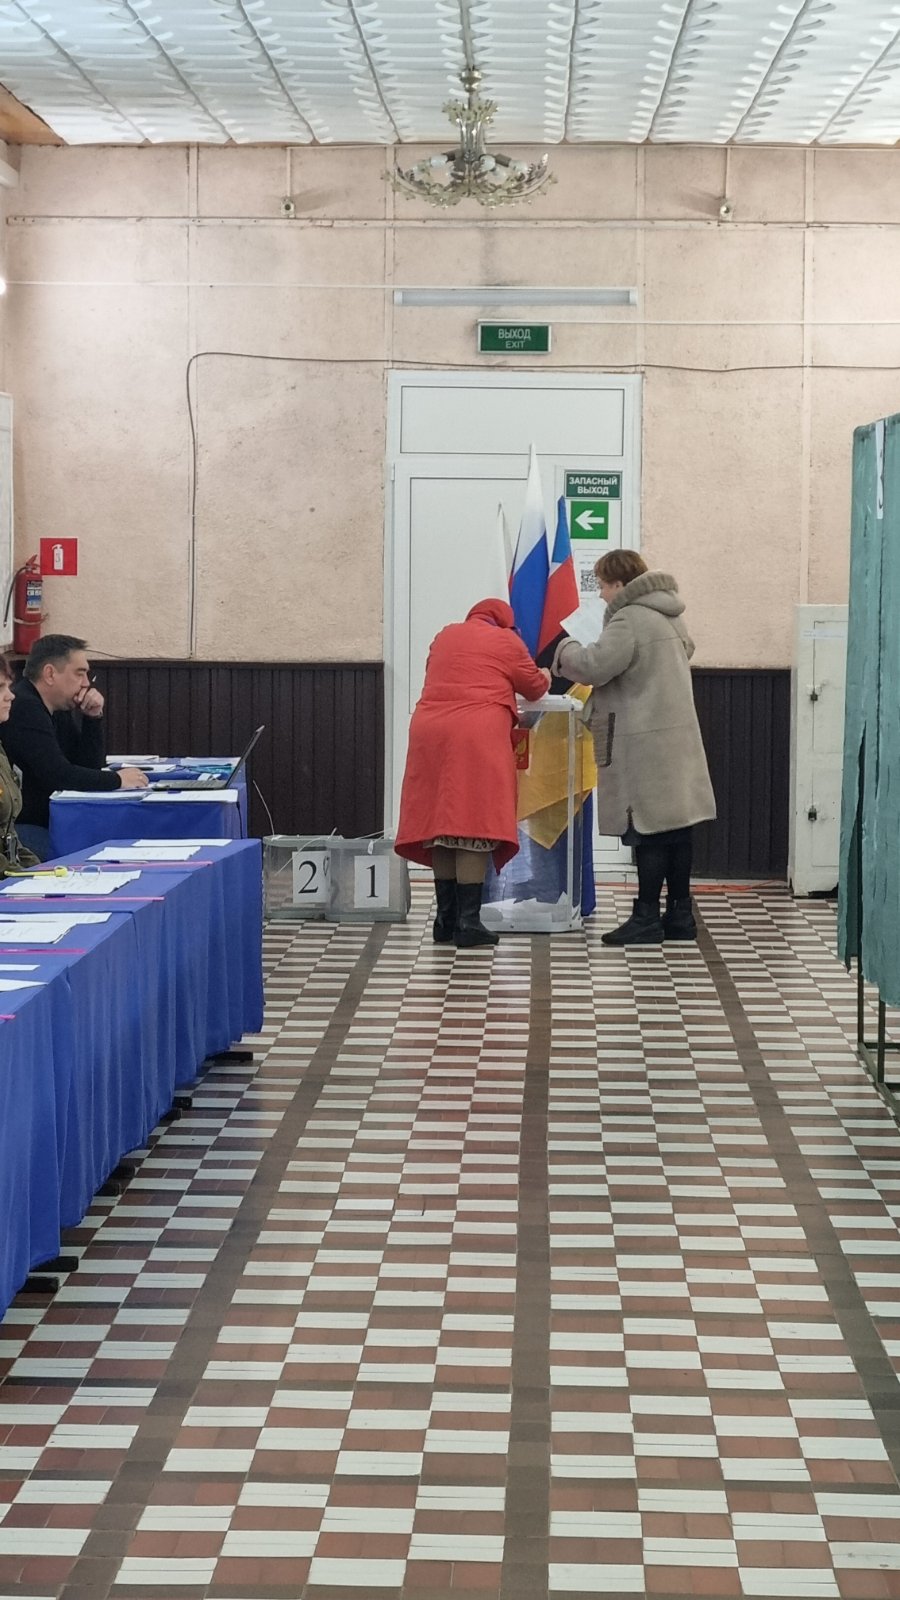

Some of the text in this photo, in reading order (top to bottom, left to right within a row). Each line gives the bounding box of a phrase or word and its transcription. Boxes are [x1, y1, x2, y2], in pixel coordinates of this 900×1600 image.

[498, 328, 531, 341] ВЫХОД
[505, 340, 525, 349] EXIT
[569, 476, 618, 485] ЗАПАСНЫЙ
[577, 486, 609, 496] ВЫХОД
[298, 860, 319, 894] 2
[365, 864, 379, 898] 1
